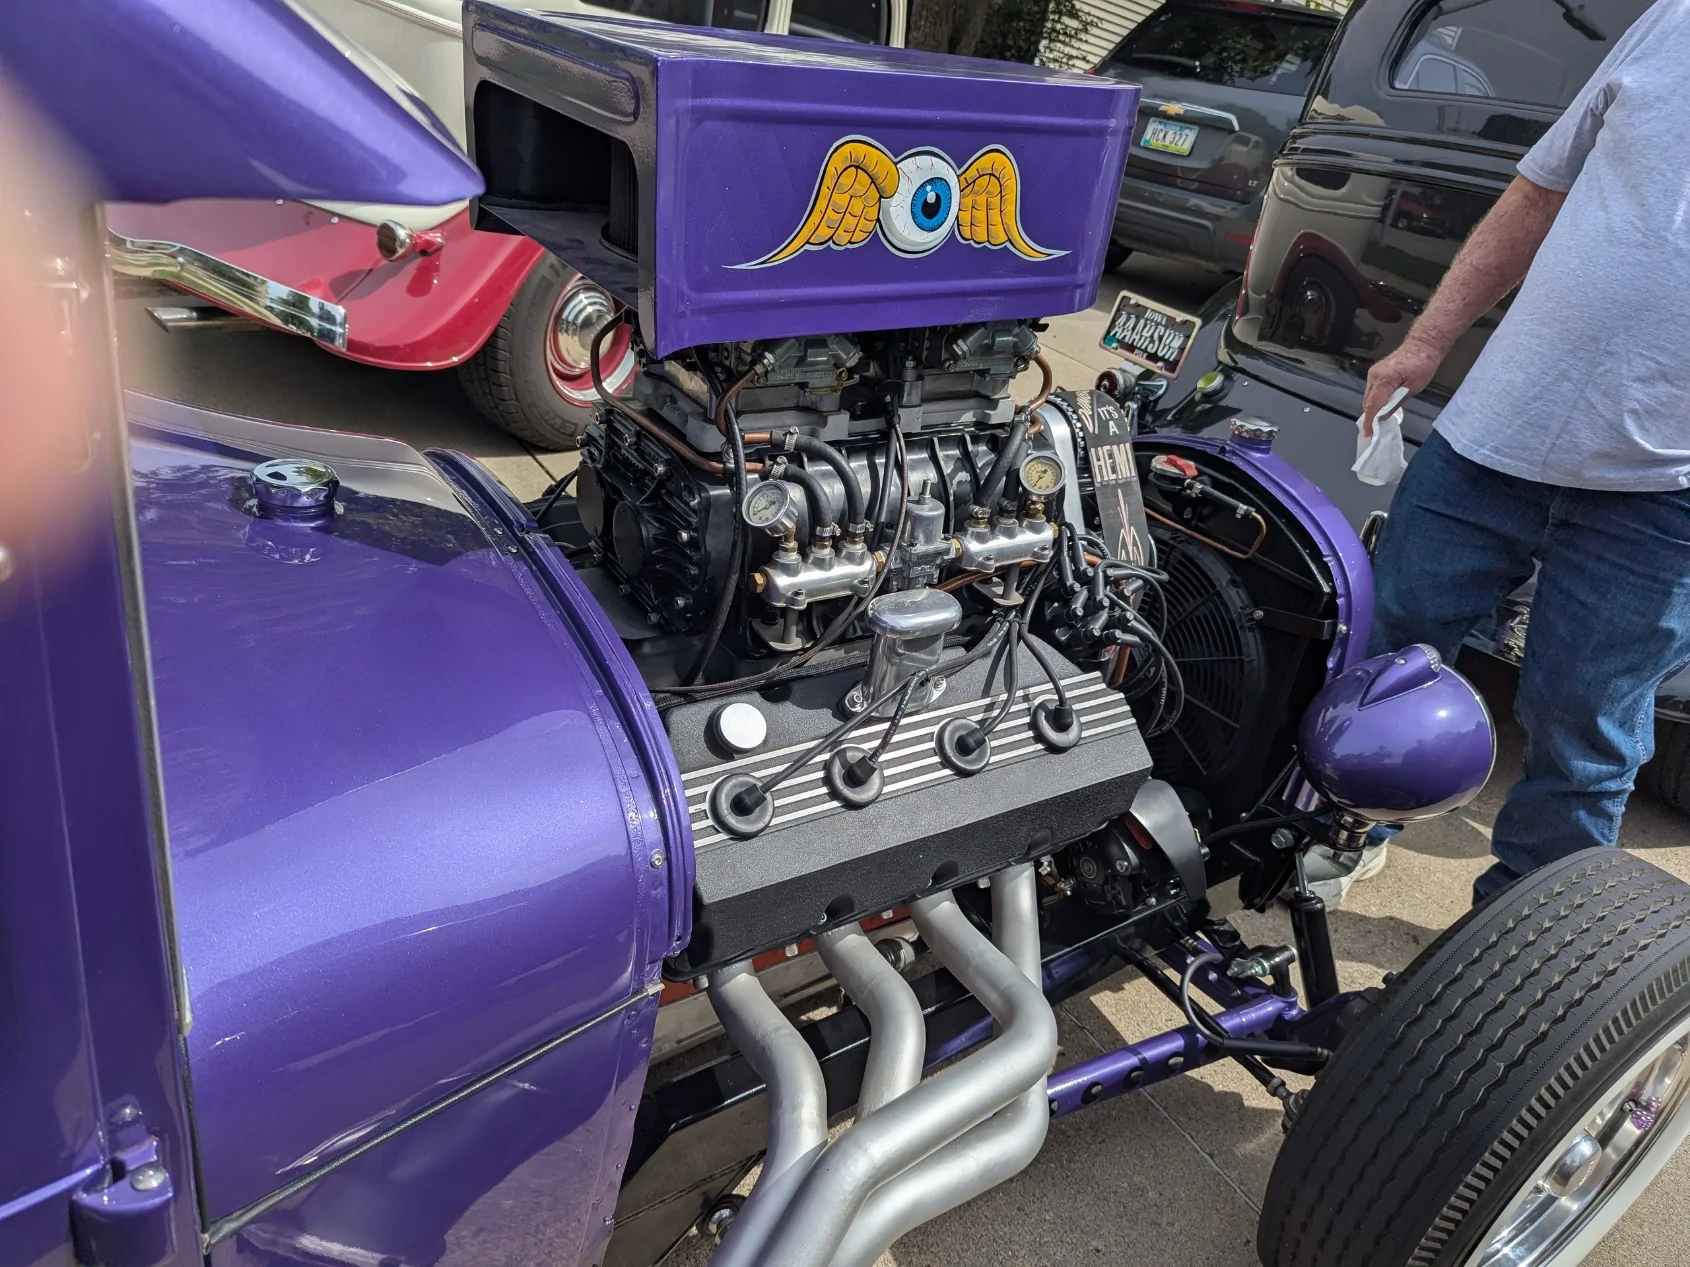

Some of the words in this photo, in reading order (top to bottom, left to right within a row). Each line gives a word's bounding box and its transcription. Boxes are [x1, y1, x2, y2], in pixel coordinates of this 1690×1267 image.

[1151, 127, 1168, 143] HCK
[1169, 131, 1189, 147] 327
[1144, 309, 1167, 325] IOWA
[961, 359, 984, 369] Holley
[1097, 404, 1119, 421] IT'S
[1108, 420, 1120, 436] A
[1090, 443, 1137, 483] HEMI
